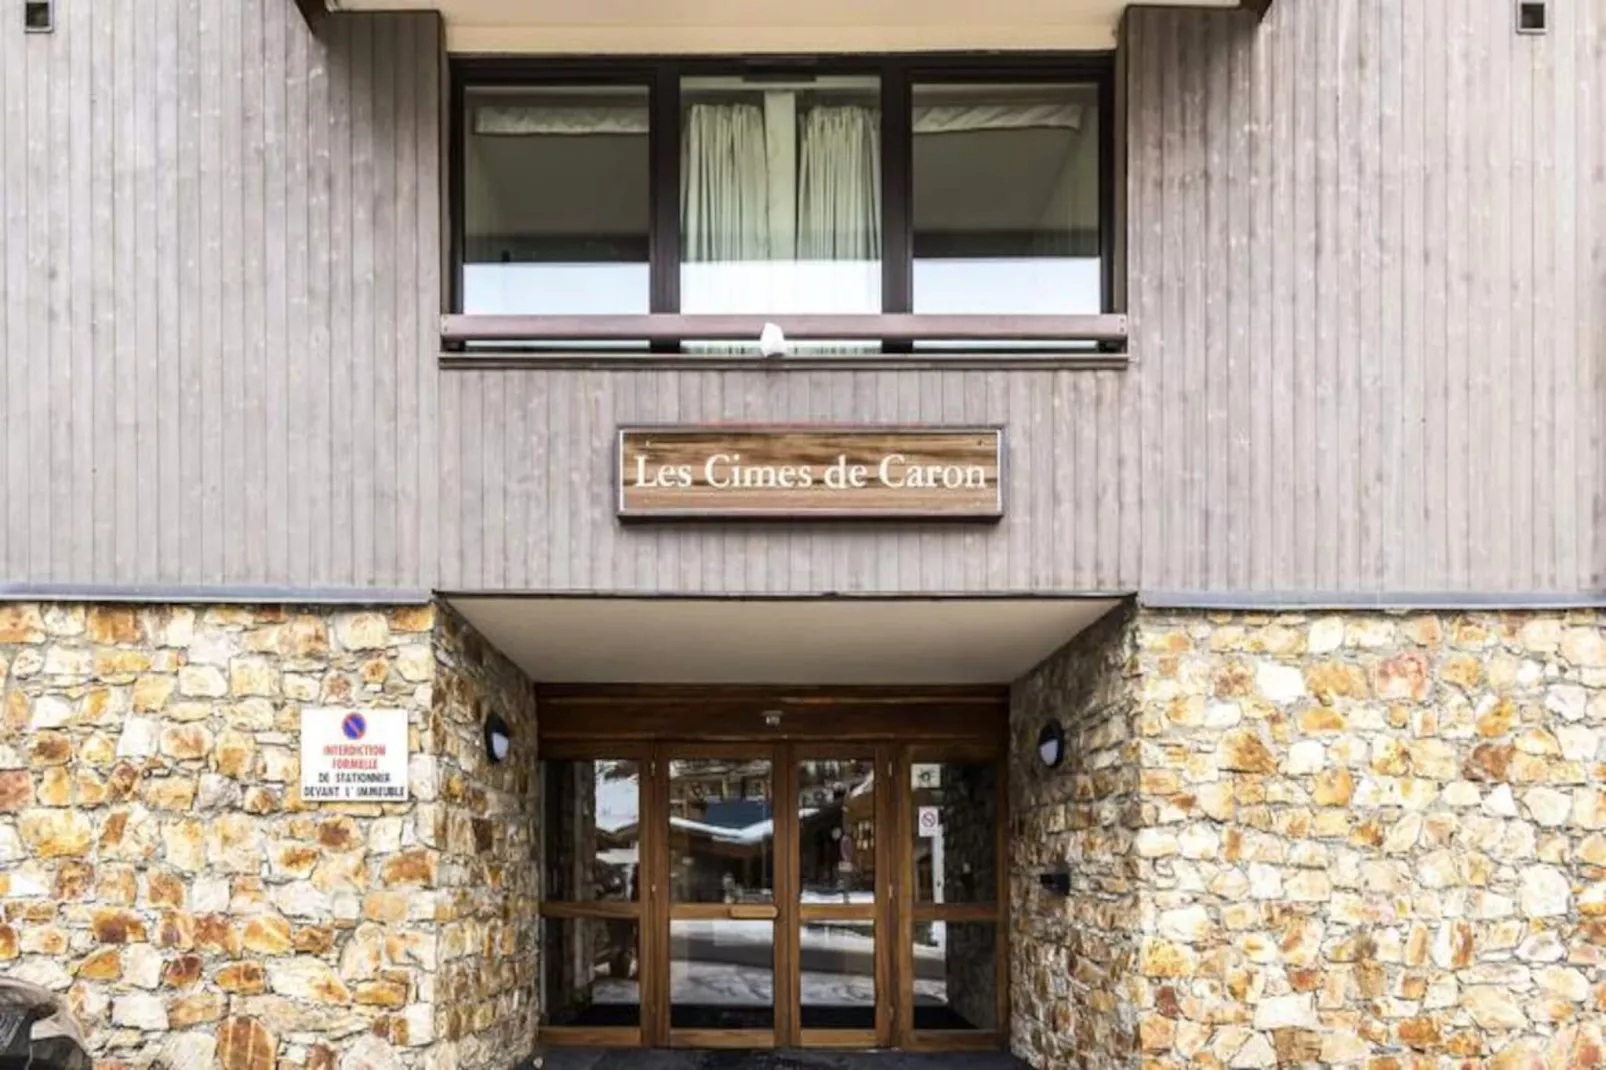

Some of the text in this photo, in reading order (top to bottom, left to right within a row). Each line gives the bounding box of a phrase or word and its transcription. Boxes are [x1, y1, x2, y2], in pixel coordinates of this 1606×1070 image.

[634, 453, 987, 488] Les Cimes de Caron
[323, 744, 386, 756] INTERDICTION
[332, 758, 378, 770] FORMELLE
[318, 772, 391, 783] DE STATIONNER
[304, 786, 340, 797] DEVANT
